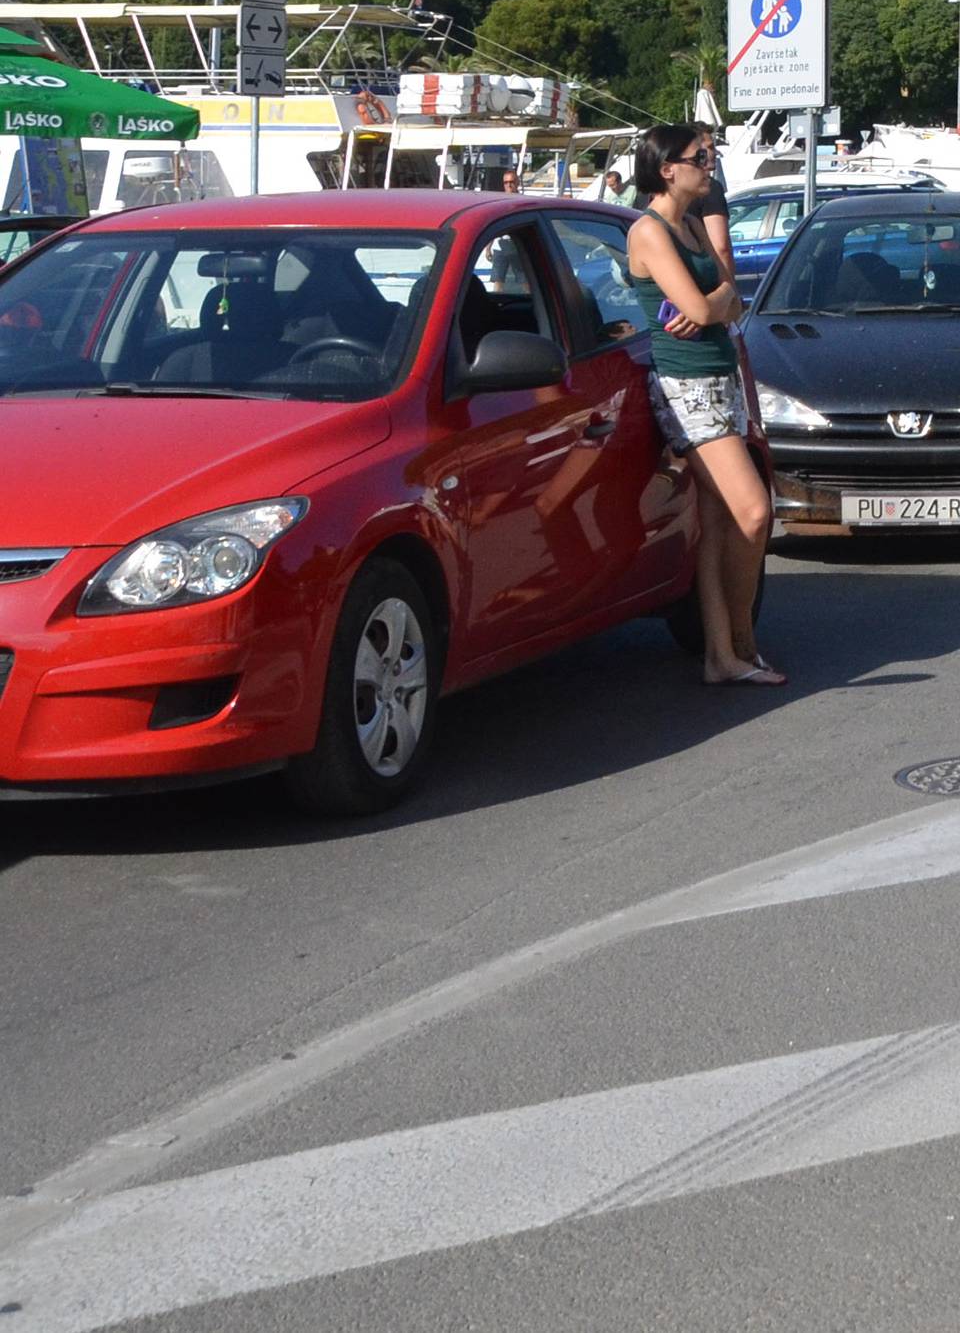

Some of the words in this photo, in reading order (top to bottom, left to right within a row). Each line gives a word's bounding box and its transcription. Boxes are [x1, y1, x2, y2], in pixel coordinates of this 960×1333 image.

[789, 62, 809, 72] zone
[734, 87, 752, 97] Fine
[756, 86, 777, 96] zona
[780, 83, 819, 97] pedonale
[6, 110, 63, 130] LAŠKO
[118, 114, 175, 135] LAŠKO
[858, 499, 883, 519] PU
